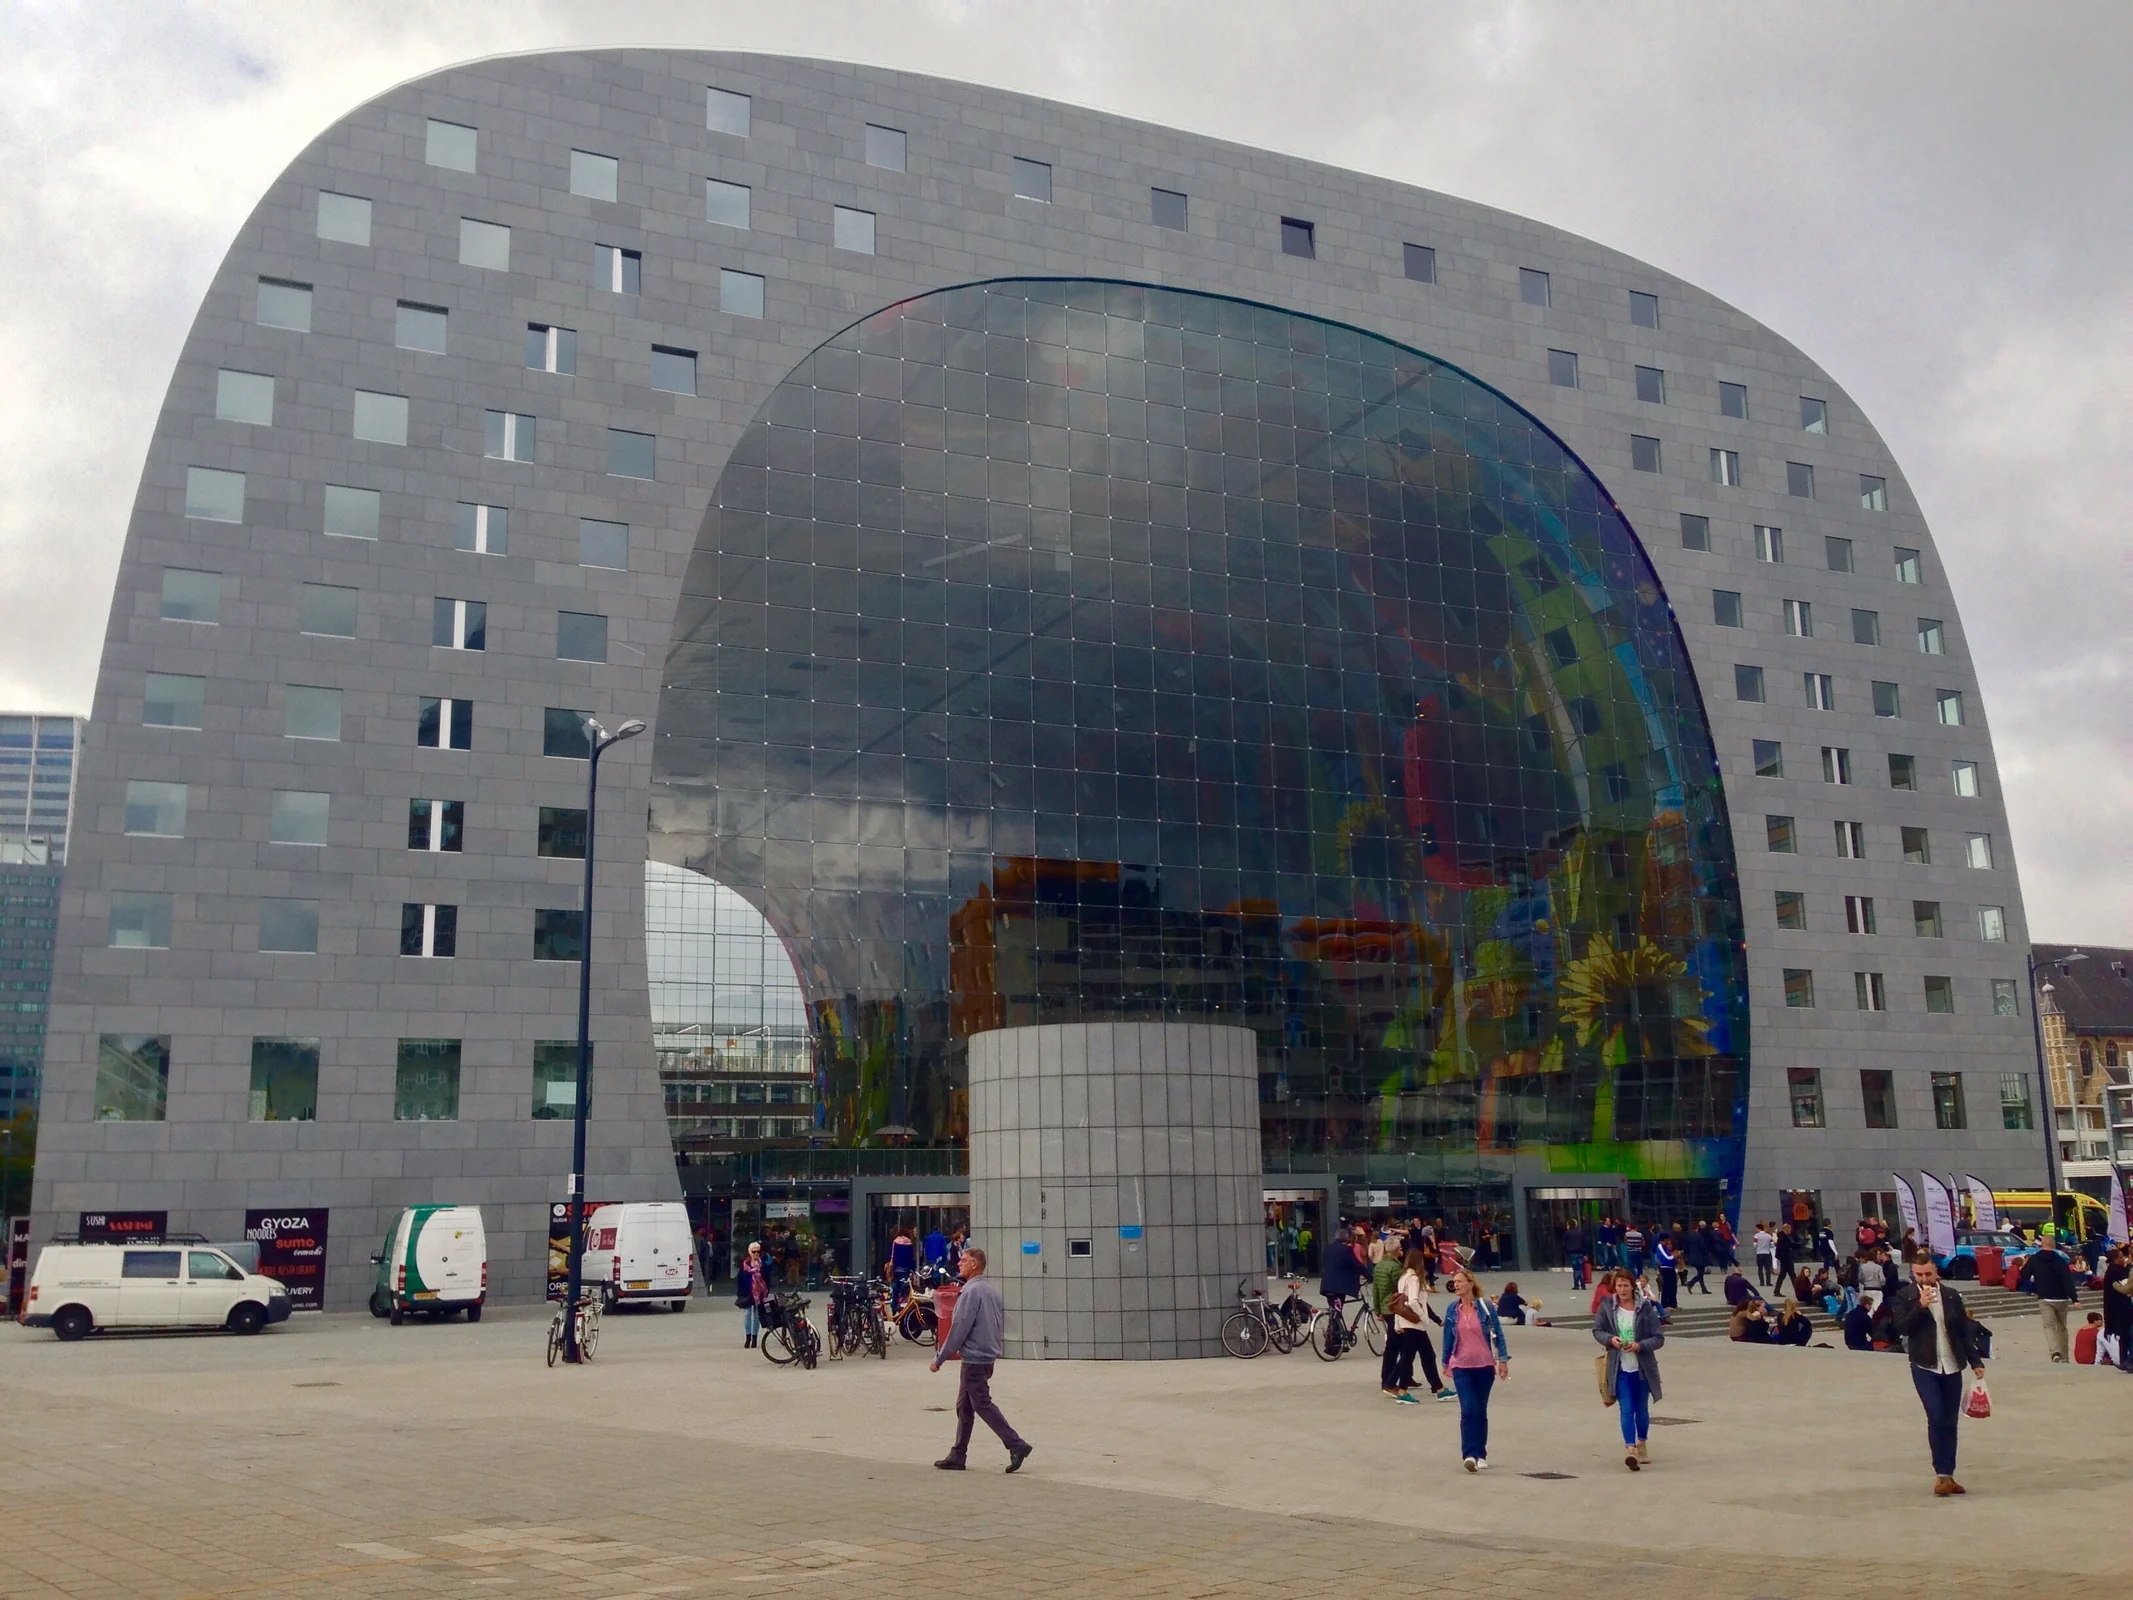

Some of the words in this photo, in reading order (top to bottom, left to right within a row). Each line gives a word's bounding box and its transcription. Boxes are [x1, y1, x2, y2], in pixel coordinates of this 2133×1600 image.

[86, 1215, 106, 1226] SUSHI
[261, 1217, 309, 1229] GYOZA
[246, 1228, 277, 1240] NOODLES
[276, 1238, 315, 1248] sumo
[286, 1287, 314, 1295] LIVERY
